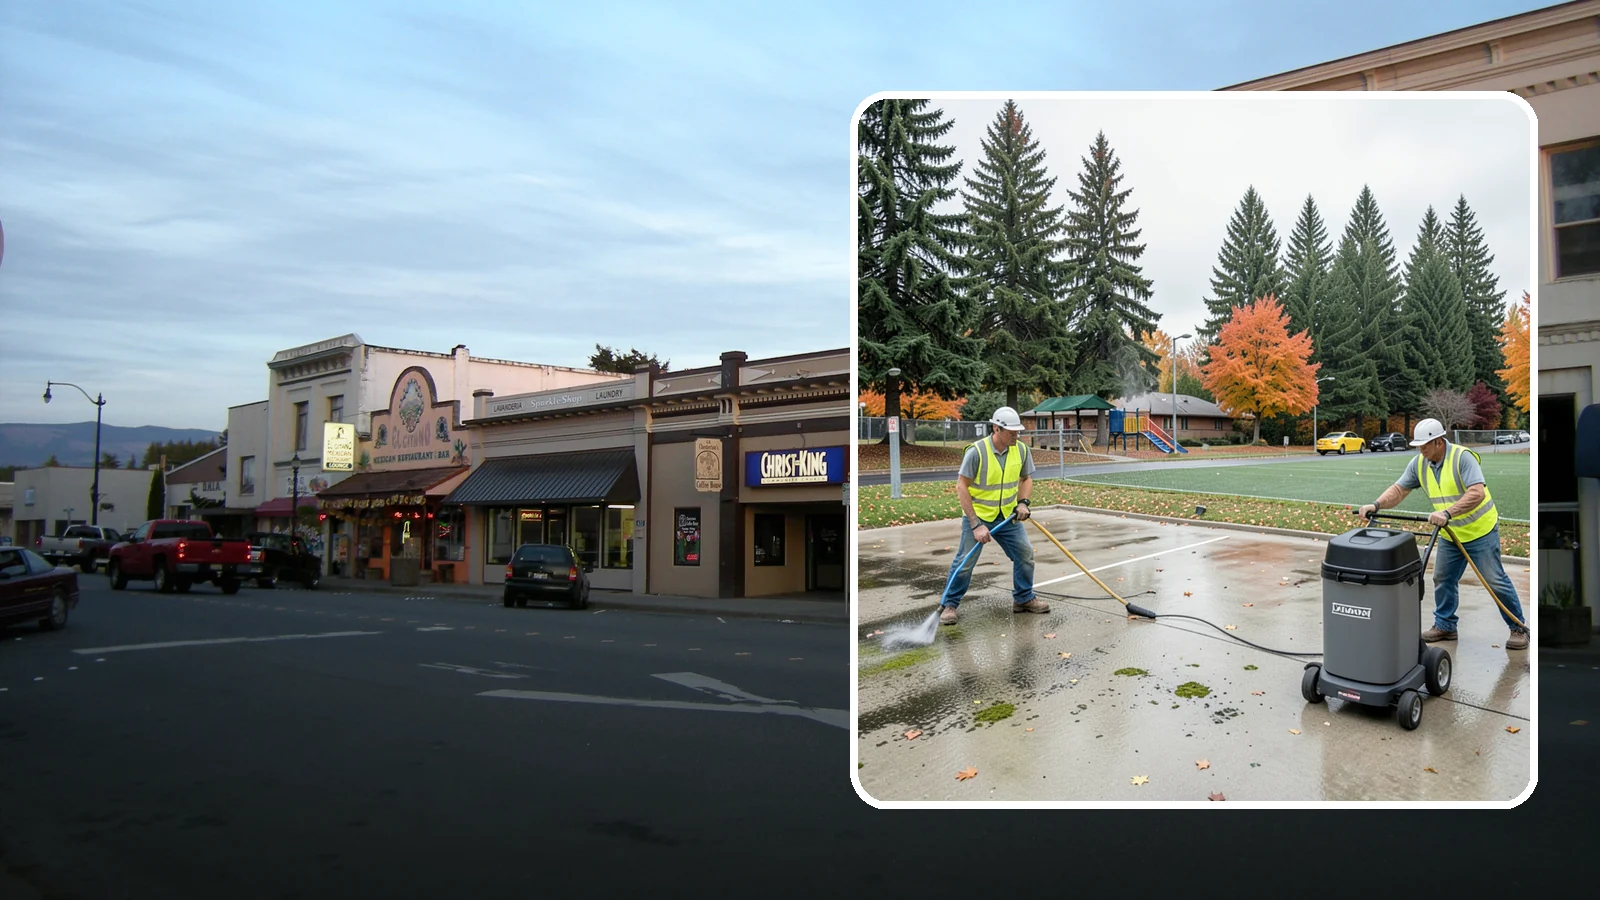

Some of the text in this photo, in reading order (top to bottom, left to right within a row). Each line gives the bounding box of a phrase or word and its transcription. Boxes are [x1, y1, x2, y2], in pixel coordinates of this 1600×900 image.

[530, 394, 583, 409] Sparkle Shop
[595, 389, 623, 400] LAUNDRY
[493, 402, 522, 413] LAVANDERIA
[373, 450, 450, 464] MEXICAN RESTAURANT BAR
[760, 452, 797, 478] CHRIST
[799, 450, 828, 476] KING
